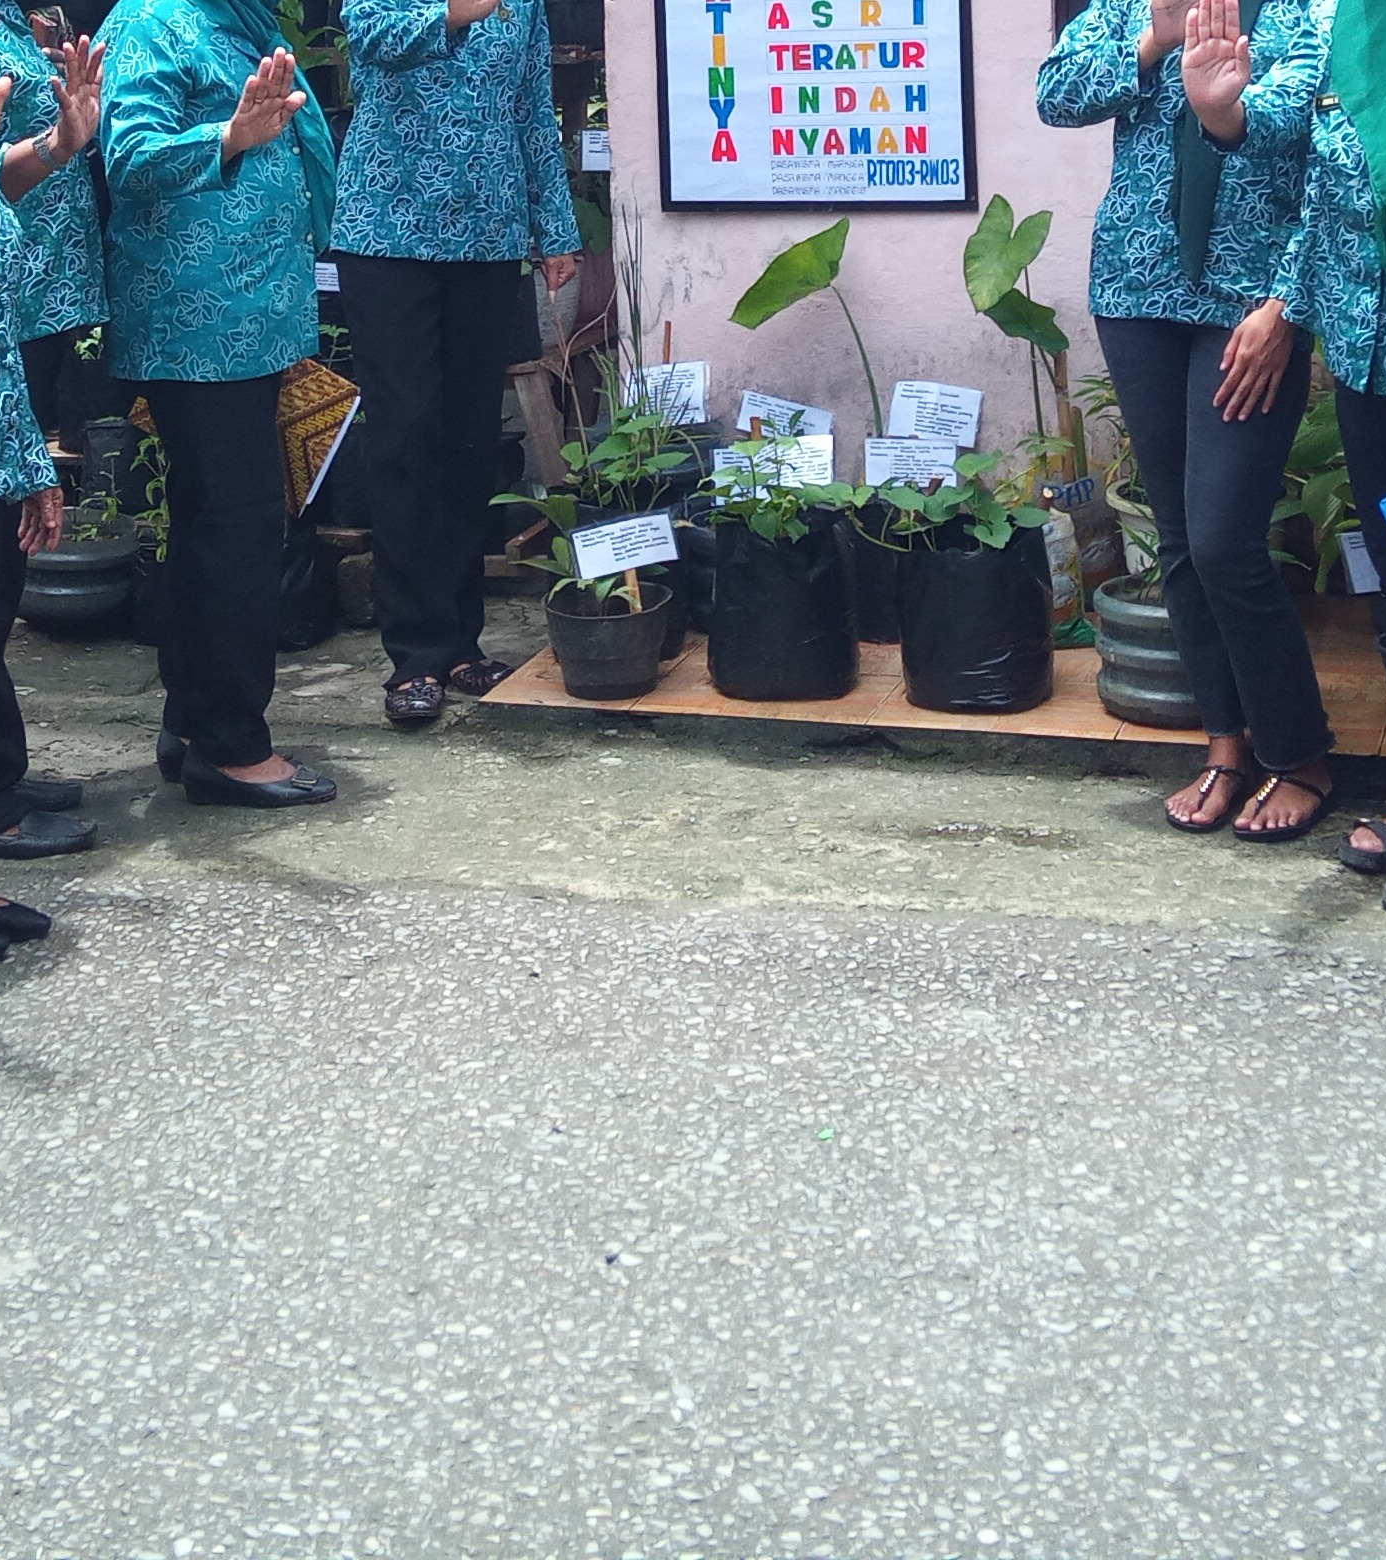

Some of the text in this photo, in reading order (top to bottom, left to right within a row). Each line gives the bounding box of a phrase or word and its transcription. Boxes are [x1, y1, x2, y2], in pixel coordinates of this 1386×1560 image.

[769, 41, 925, 72] TERATUR
[770, 84, 926, 115] INDAH
[772, 126, 927, 156] NYAMAN
